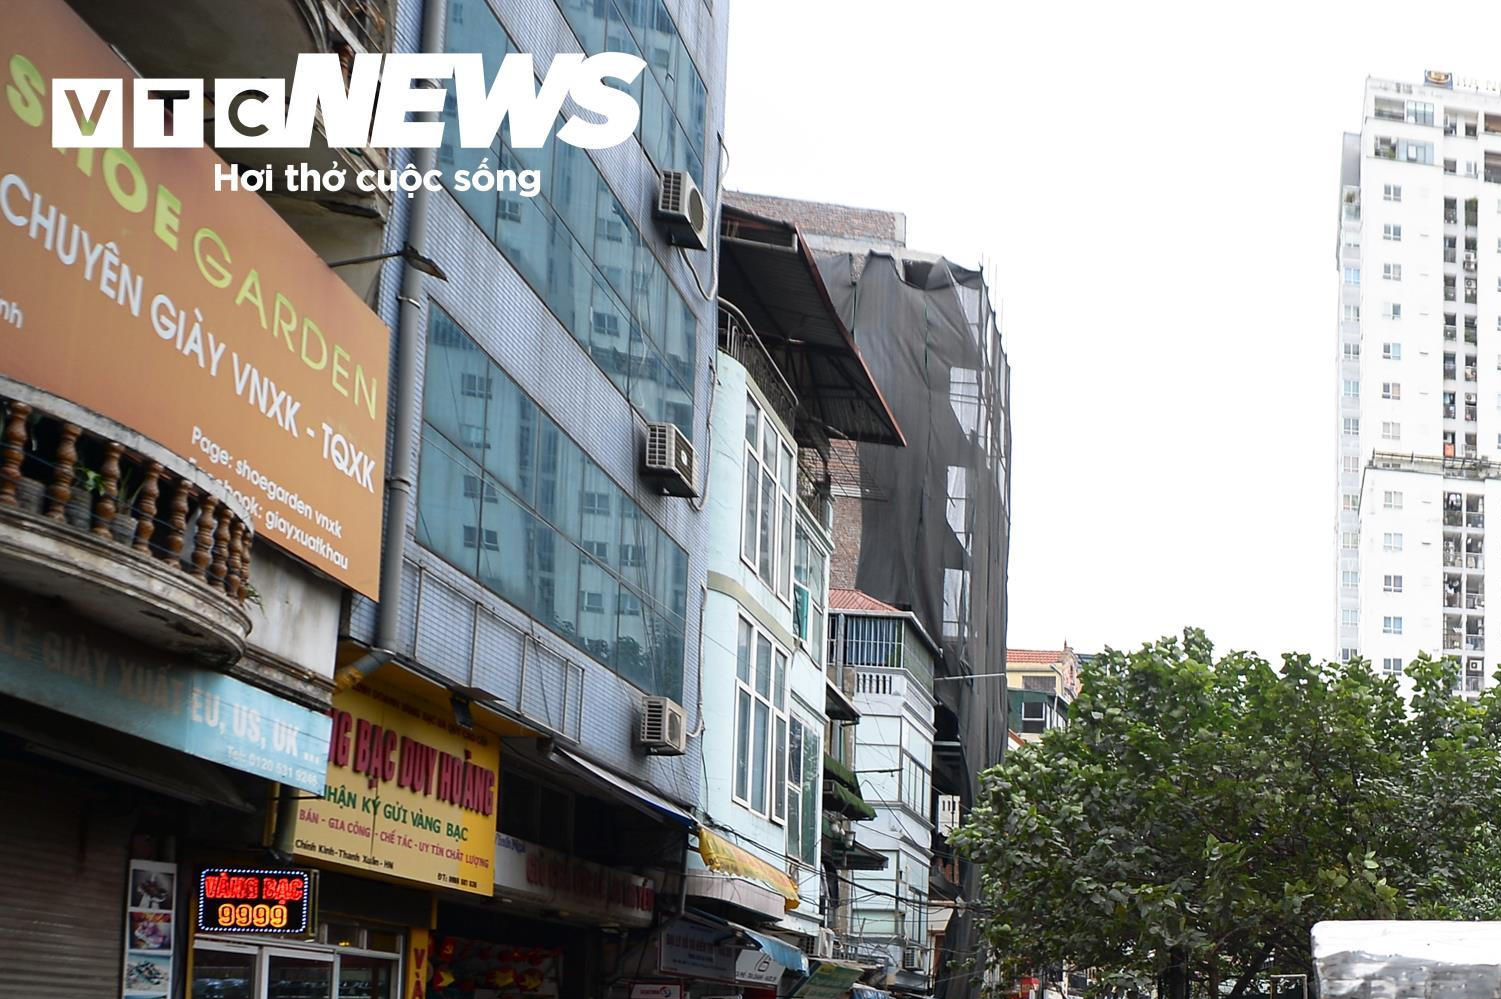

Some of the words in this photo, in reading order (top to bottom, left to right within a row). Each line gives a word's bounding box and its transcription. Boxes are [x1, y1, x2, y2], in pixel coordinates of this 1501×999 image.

[6, 53, 182, 252] SOE
[193, 227, 377, 420] GARDEN
[0, 173, 144, 317] CHUYÊN
[151, 294, 226, 377] GIÀY
[232, 352, 301, 438] VNXK
[322, 422, 376, 494] TQXK
[191, 426, 233, 468] Page:
[235, 459, 313, 520] shoegarden
[315, 510, 342, 539] vnxk
[190, 687, 227, 735] EU,
[232, 702, 267, 749] US,
[352, 718, 397, 789] BẠC
[397, 736, 438, 797] DUY
[437, 748, 495, 817] HOÀNG
[299, 808, 319, 825] BÁN
[328, 817, 345, 832] GIA
[347, 820, 371, 839] CÔNG
[380, 828, 395, 845] CHẾ
[396, 833, 413, 850] TÁC
[418, 841, 429, 853] UY
[362, 792, 380, 816] KÝ
[383, 800, 408, 824] GỬI
[410, 807, 441, 834] VÀNG
[446, 822, 469, 843] BẠC
[205, 871, 258, 899] VÀNG
[262, 877, 304, 905] BẠC
[218, 903, 288, 928] 9999
